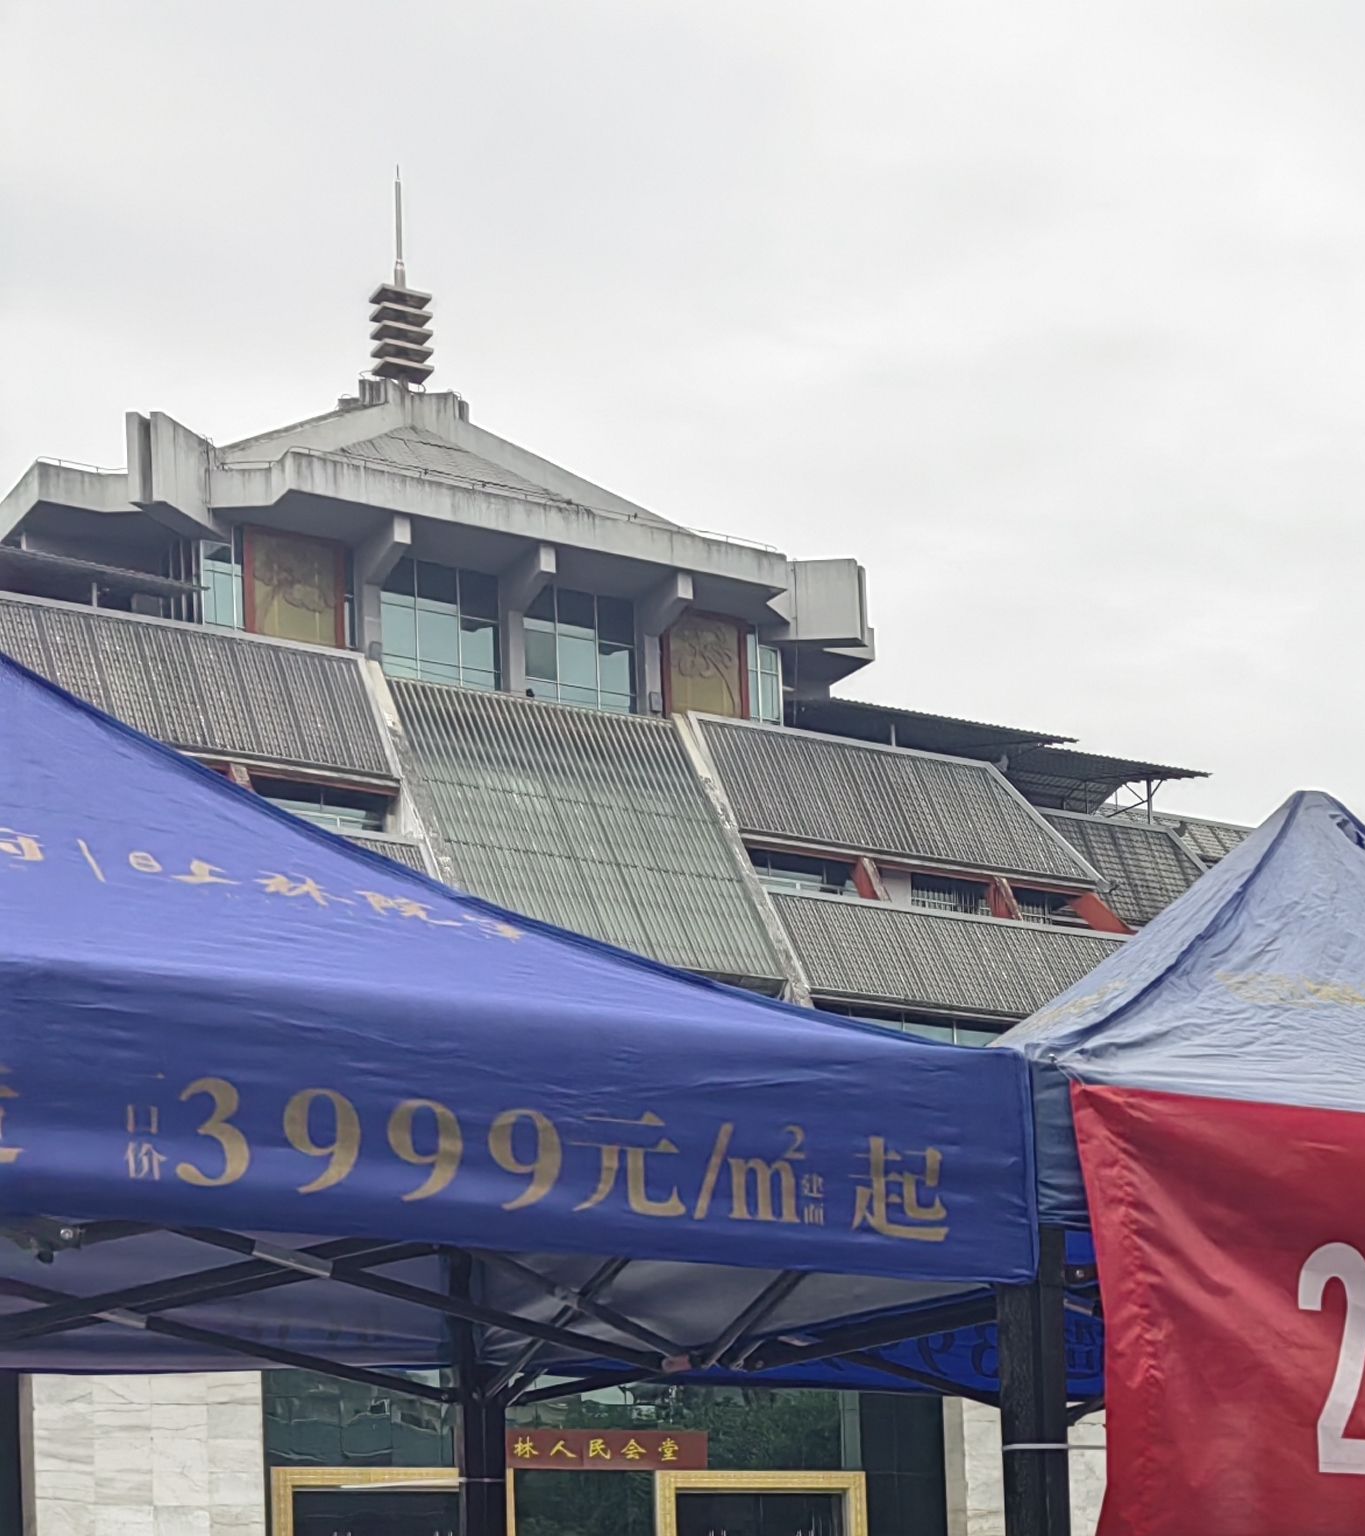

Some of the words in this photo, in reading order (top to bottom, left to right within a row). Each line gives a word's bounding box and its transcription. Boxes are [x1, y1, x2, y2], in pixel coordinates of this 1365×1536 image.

[512, 1436, 679, 1462] 林人民会堂
